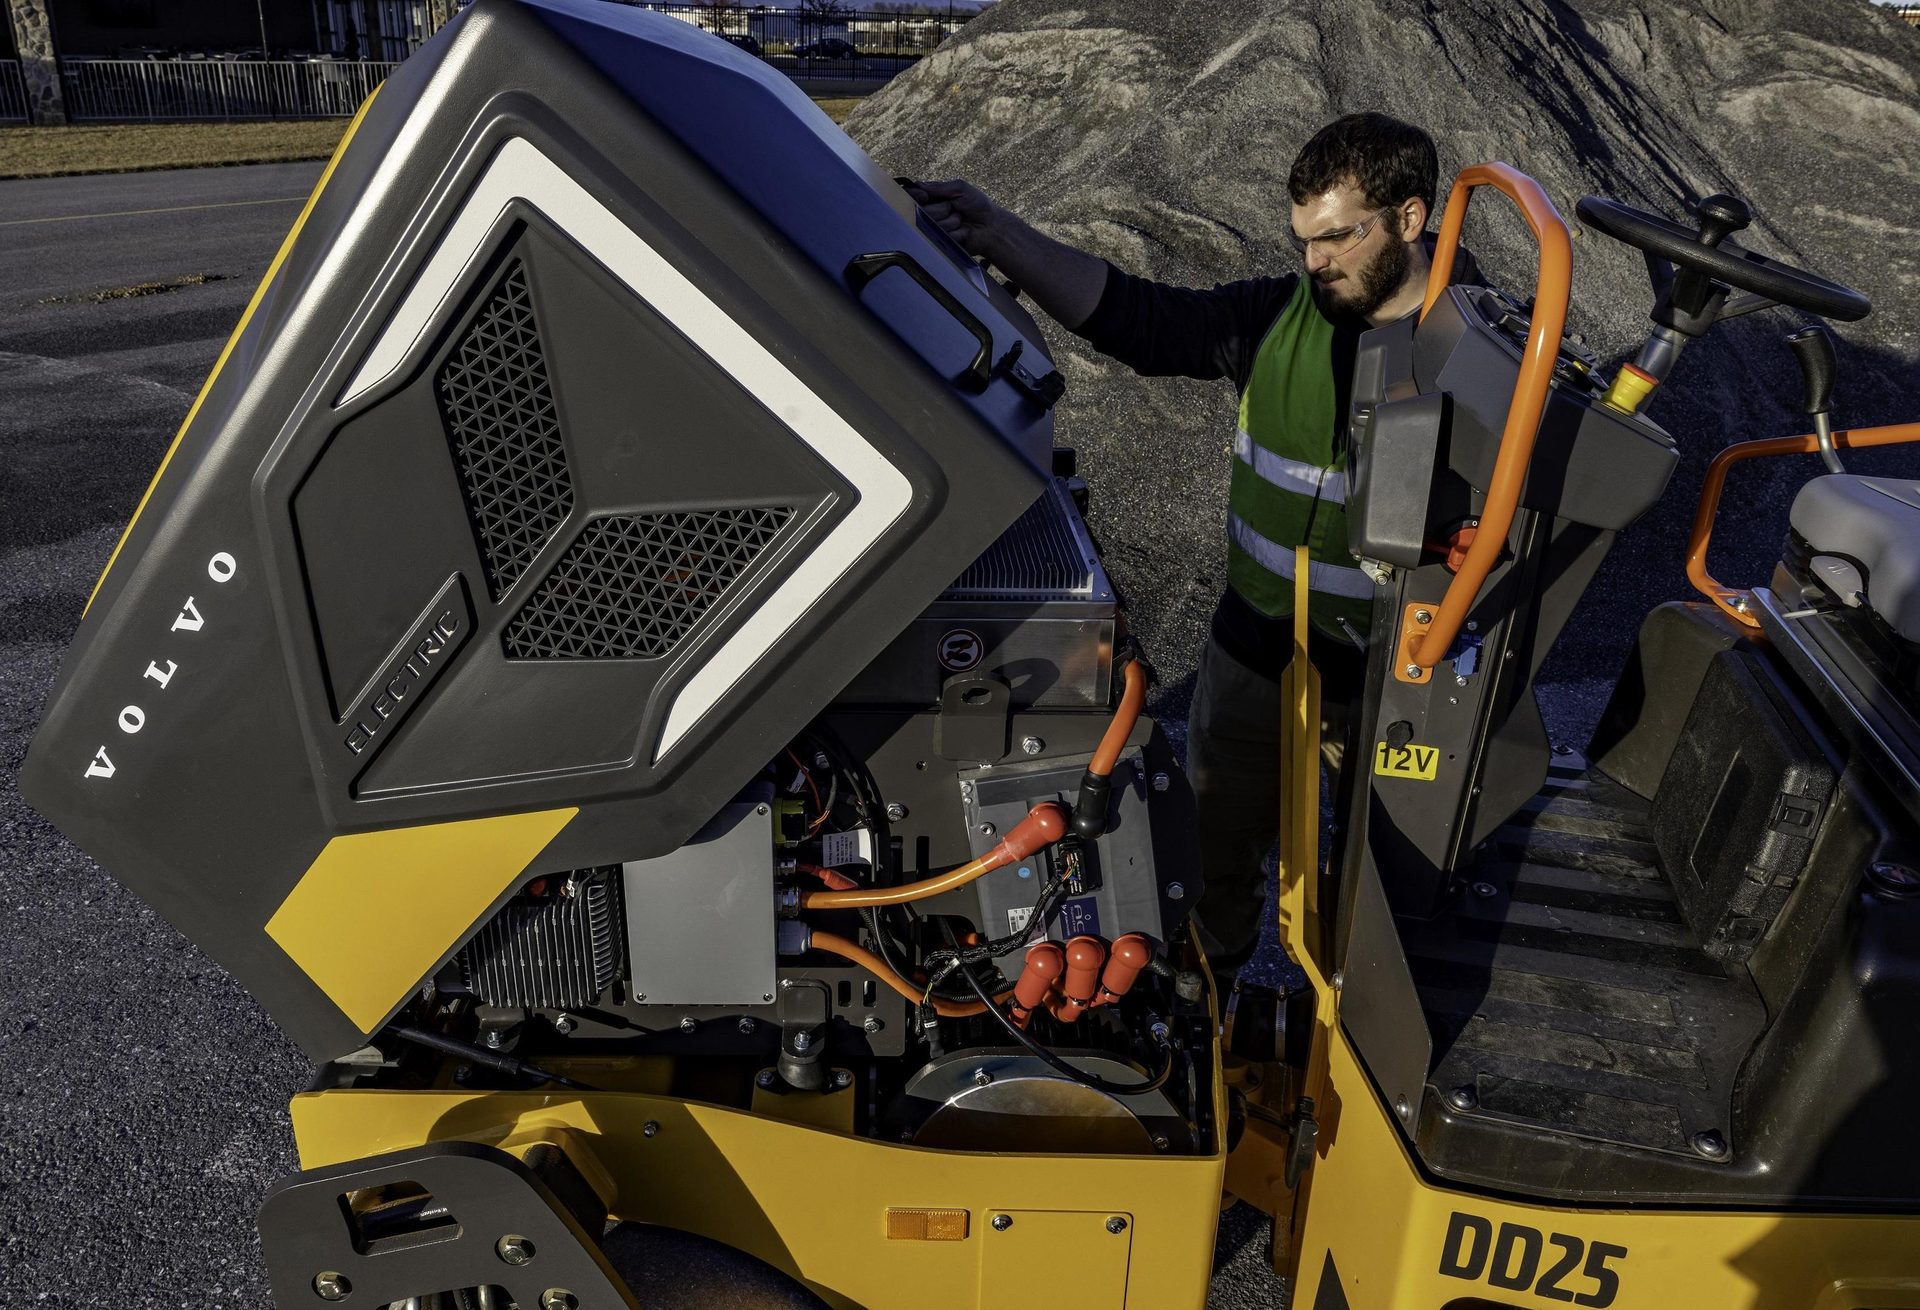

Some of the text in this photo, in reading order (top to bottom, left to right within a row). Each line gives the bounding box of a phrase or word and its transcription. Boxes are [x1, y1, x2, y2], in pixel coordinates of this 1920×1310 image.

[84, 551, 237, 779] VOLVO
[344, 610, 460, 757] ELECTRIC
[1379, 746, 1435, 773] 12V
[1438, 1210, 1628, 1309] DD25
